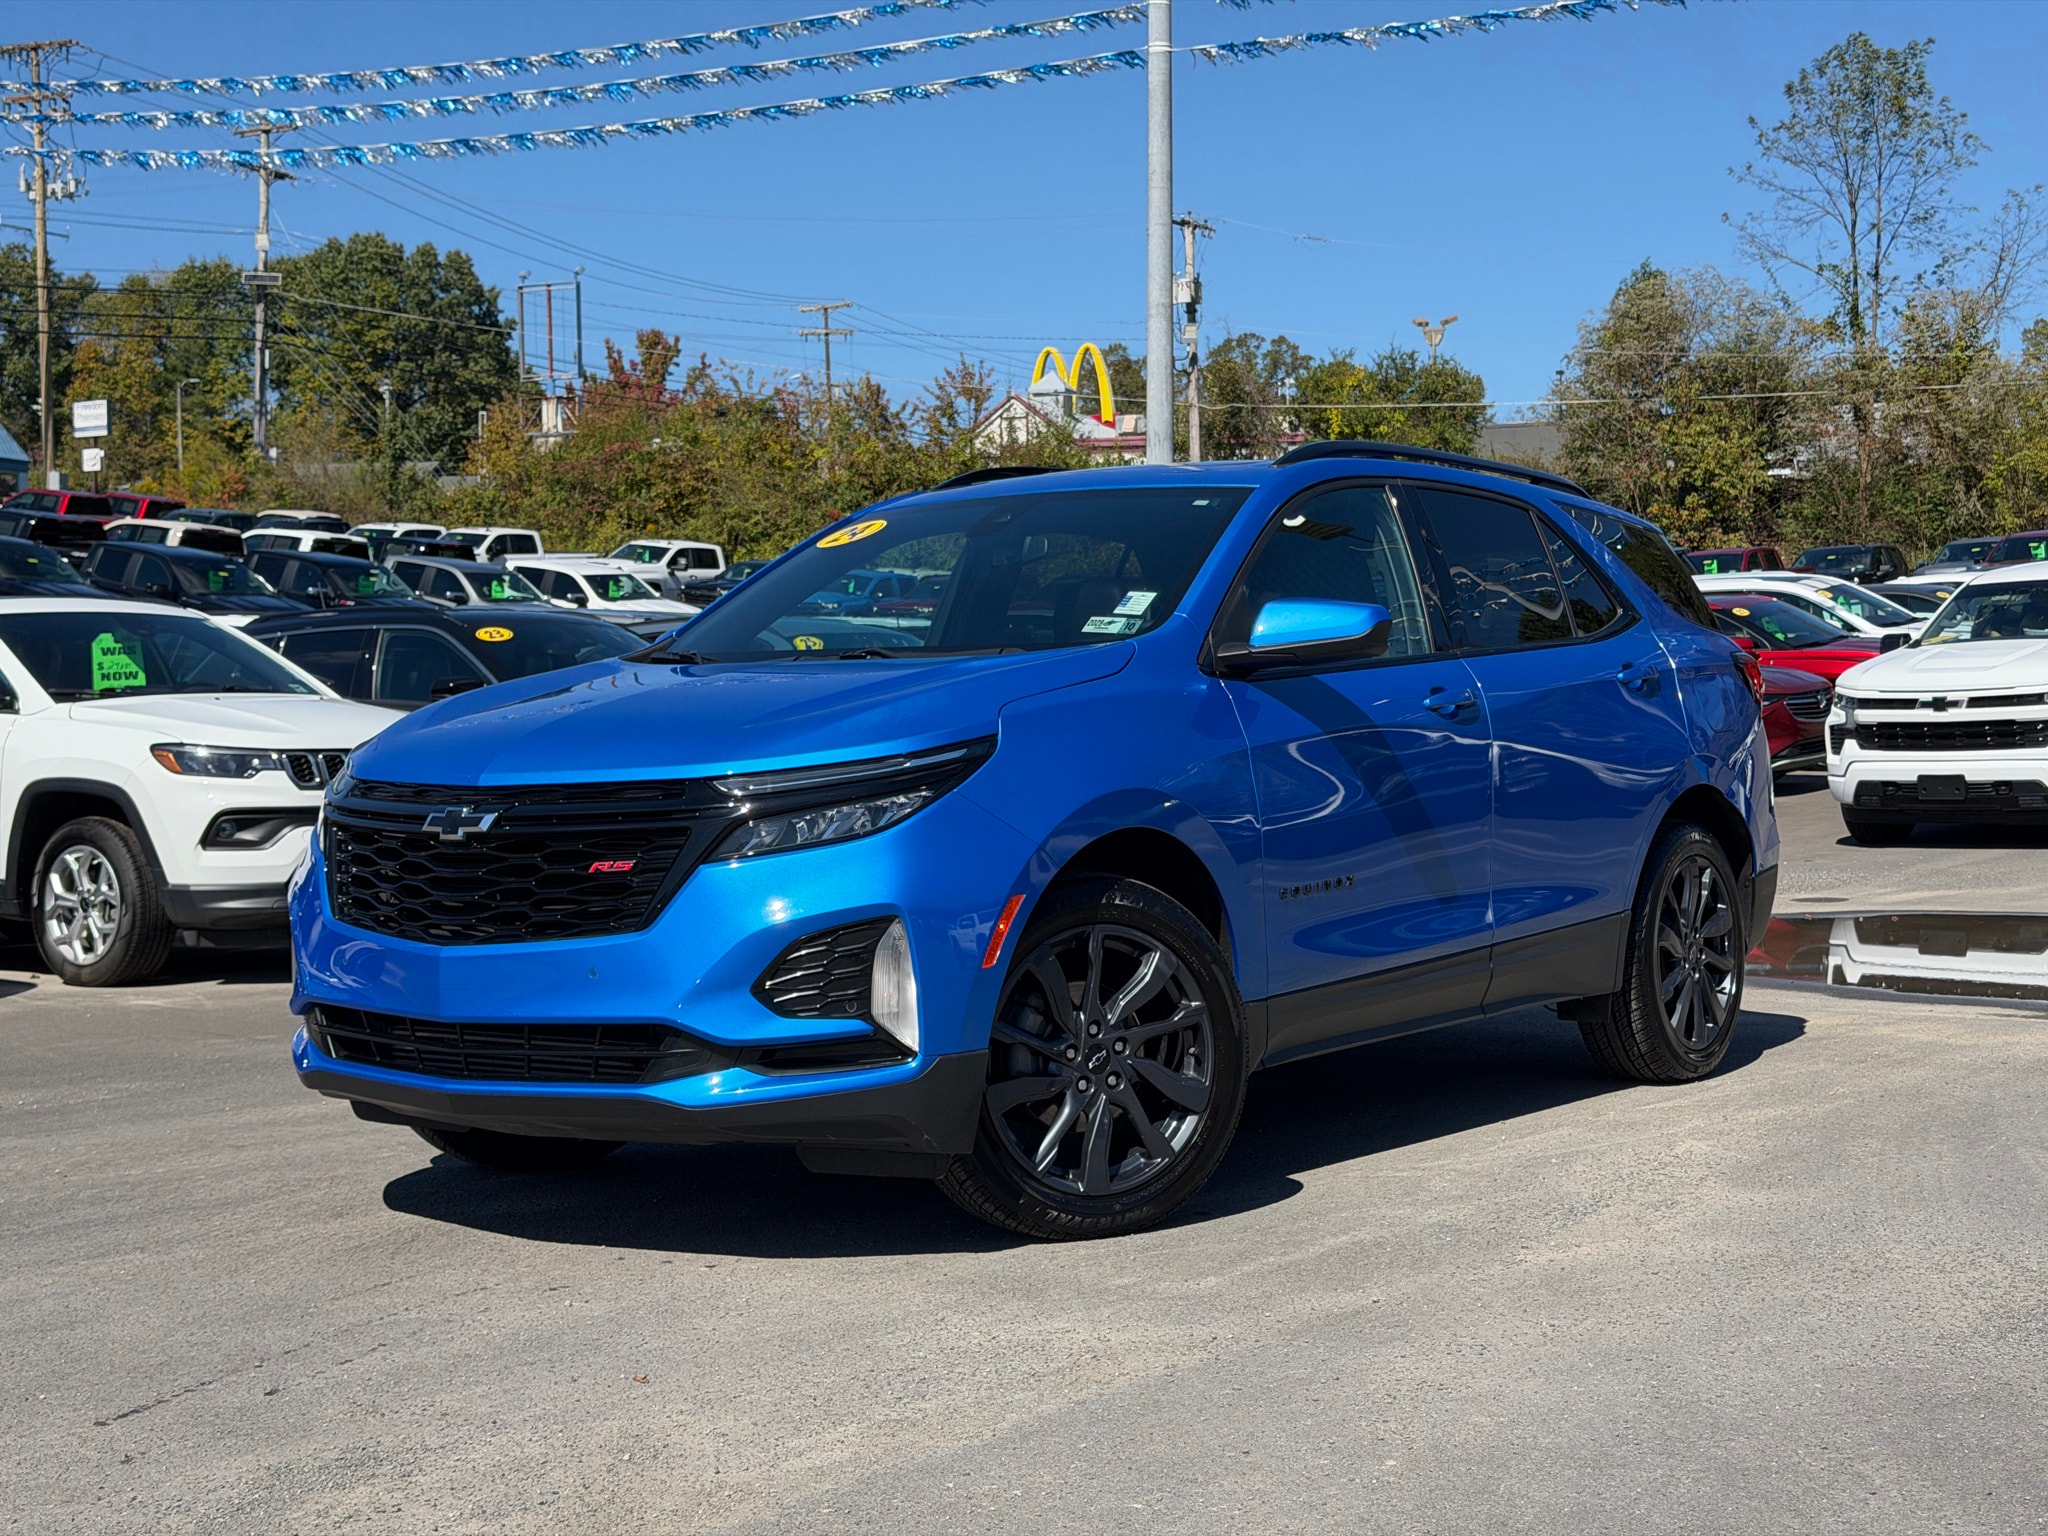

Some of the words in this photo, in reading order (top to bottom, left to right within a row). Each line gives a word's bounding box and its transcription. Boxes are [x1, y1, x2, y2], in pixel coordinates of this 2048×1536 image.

[1123, 621, 1136, 631] 10
[100, 646, 137, 656] WAS
[100, 671, 139, 681] NOW
[588, 861, 636, 873] RS
[1280, 875, 1354, 900] EQUINOX
